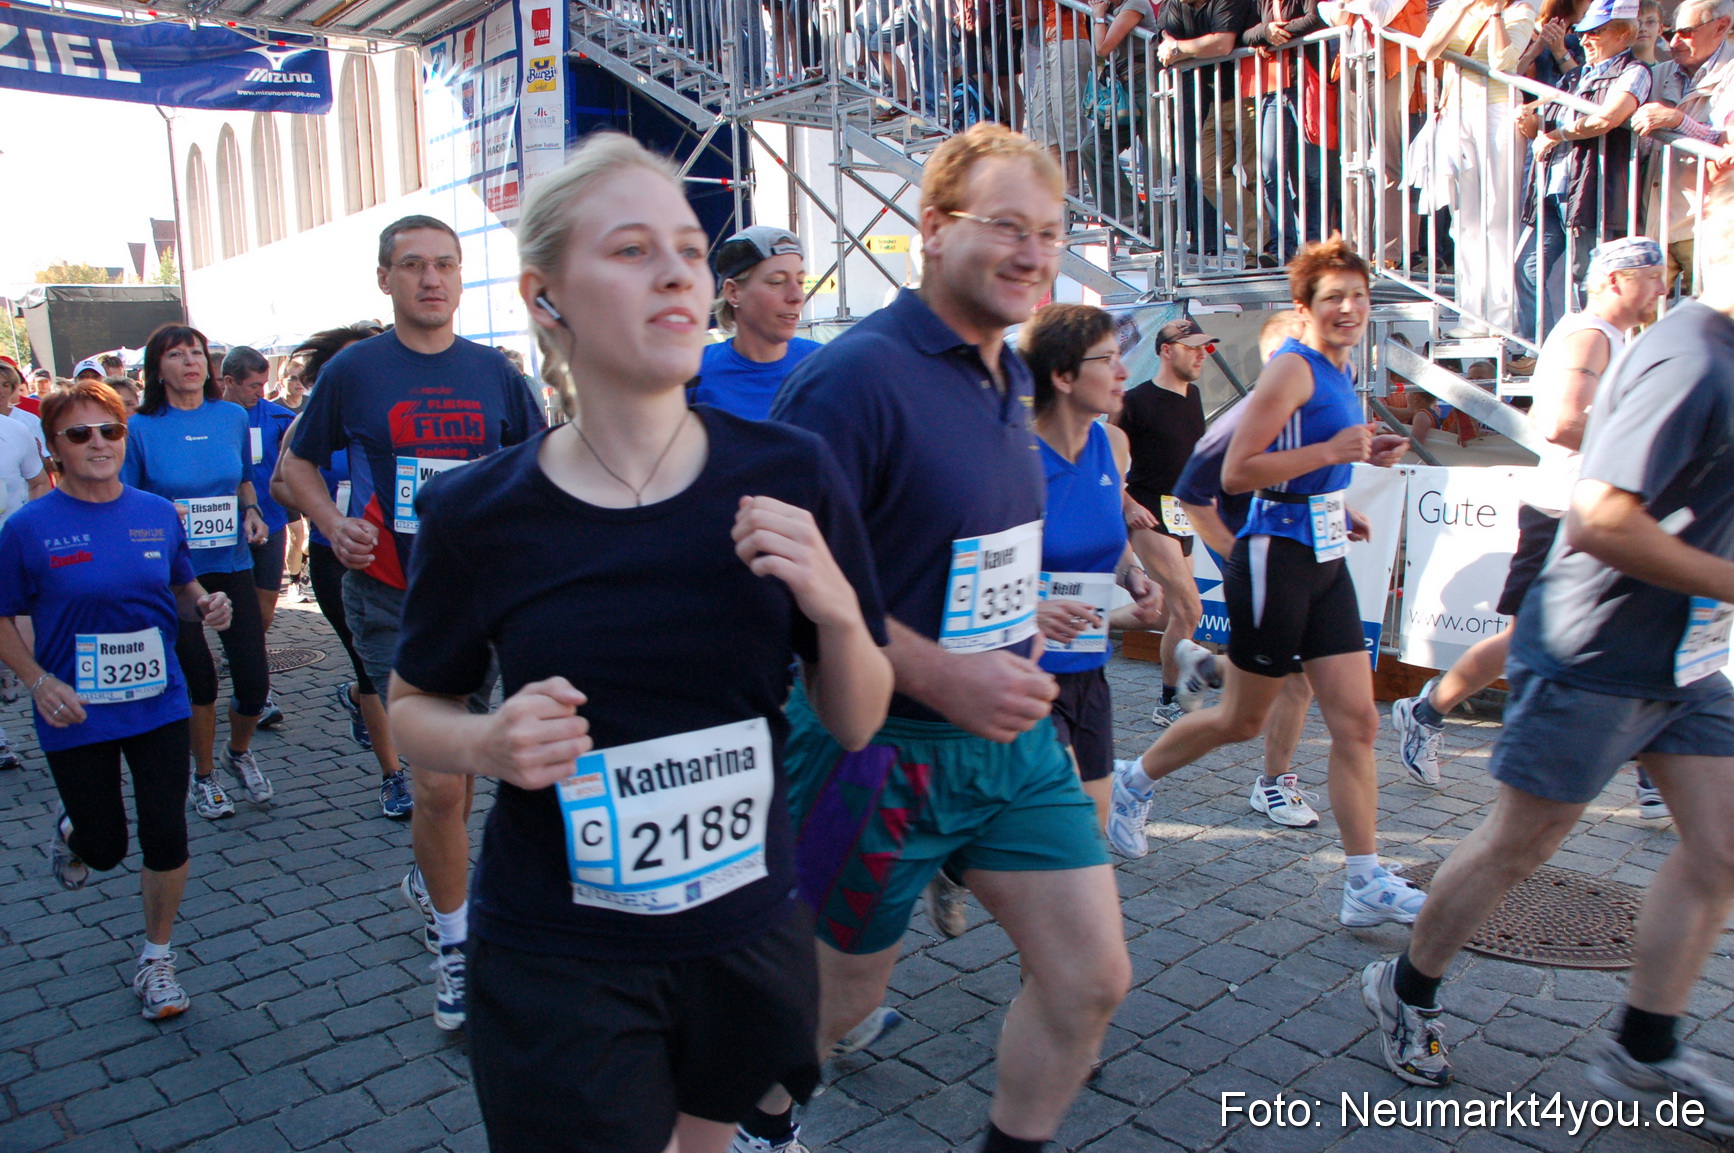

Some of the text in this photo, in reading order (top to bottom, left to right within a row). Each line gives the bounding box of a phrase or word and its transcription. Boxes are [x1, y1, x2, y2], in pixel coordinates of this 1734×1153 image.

[0, 22, 141, 83] ZIEL
[237, 89, 321, 98] www.mizunoeurope.com
[413, 415, 481, 438] Fink
[401, 486, 411, 498] C
[191, 503, 231, 513] Elisabeth
[1419, 490, 1497, 527] Gute
[193, 518, 234, 535] 2904
[44, 534, 91, 548] FALKE
[954, 584, 972, 602] C
[100, 642, 145, 655] Renate
[82, 661, 92, 672] C
[103, 659, 160, 685] 3293
[614, 747, 756, 798] Katharina
[581, 820, 604, 846] C
[631, 798, 754, 872] 2188
